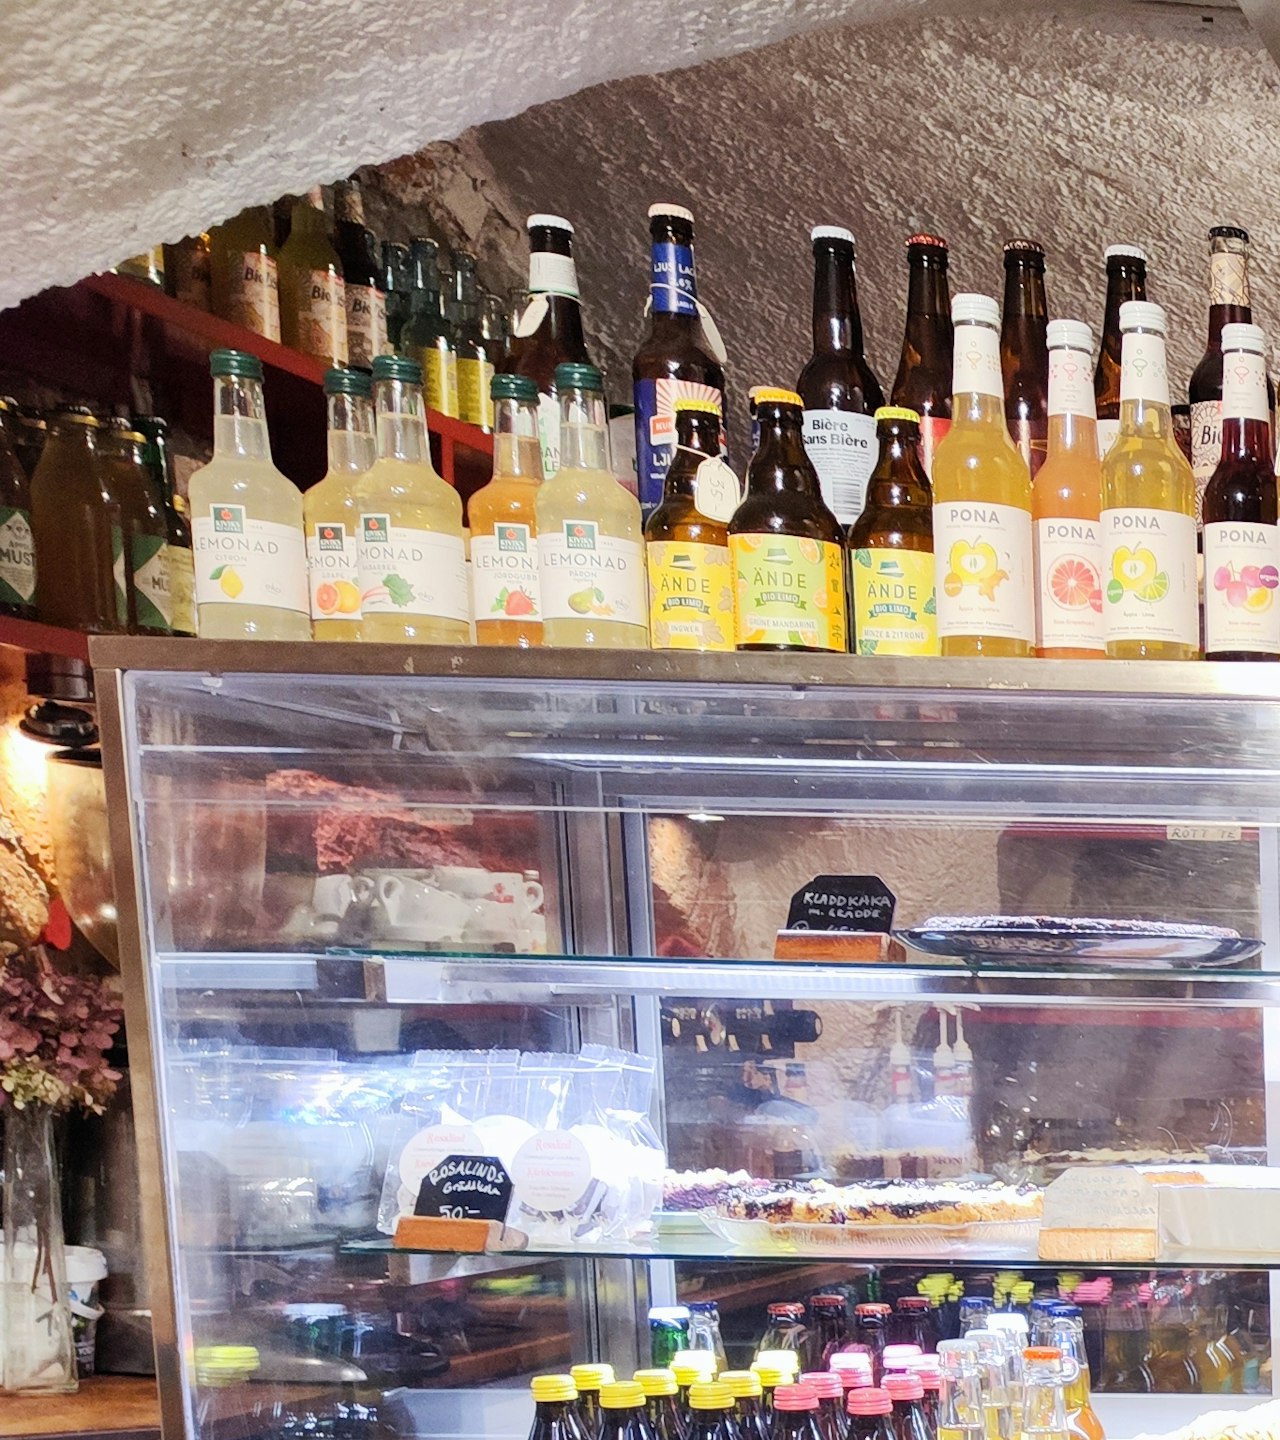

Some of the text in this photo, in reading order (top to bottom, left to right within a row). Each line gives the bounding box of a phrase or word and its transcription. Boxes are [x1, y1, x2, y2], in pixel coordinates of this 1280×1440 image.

[812, 418, 849, 433] Bière
[829, 433, 869, 449] Bière
[950, 508, 1000, 525] PONA
[1112, 515, 1161, 530] PONA
[1047, 525, 1096, 540] PONA
[1219, 529, 1267, 544] PONA
[544, 553, 627, 570] LEMONAD
[661, 574, 710, 594] ÄNDE
[753, 568, 807, 589] ÄNDE
[867, 582, 917, 600] ÄNDE
[429, 1159, 505, 1184] ROSALINDS
